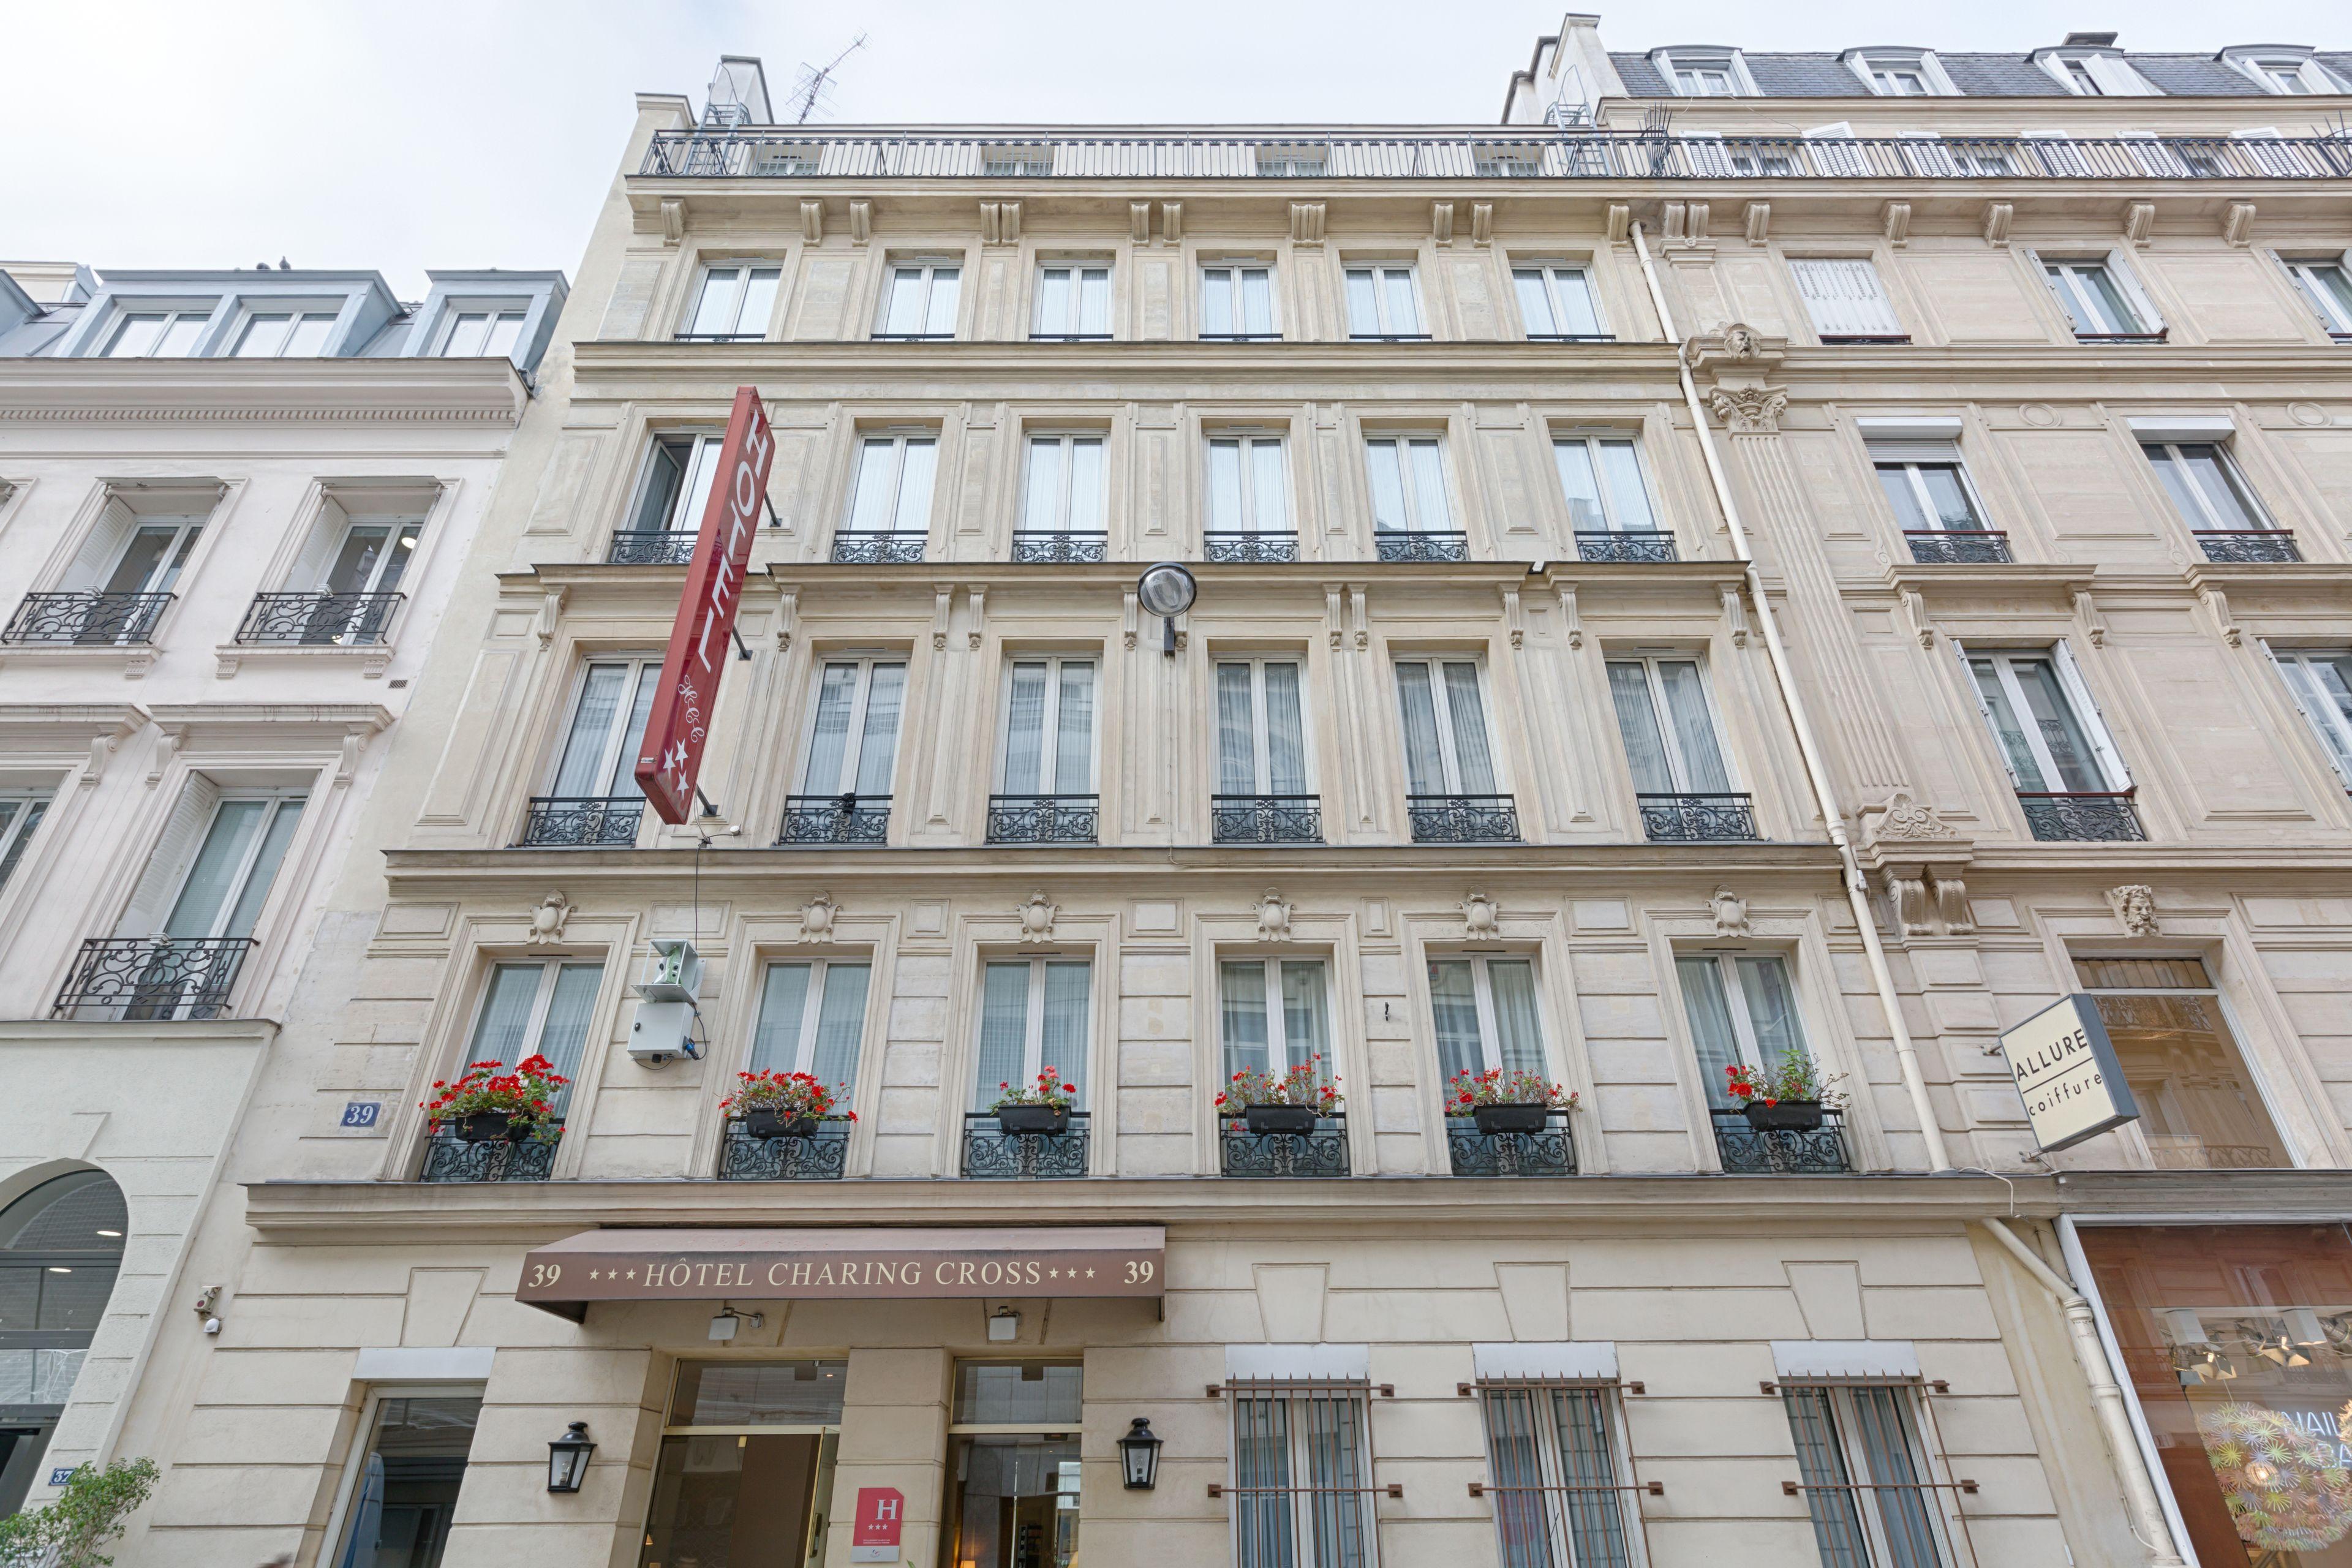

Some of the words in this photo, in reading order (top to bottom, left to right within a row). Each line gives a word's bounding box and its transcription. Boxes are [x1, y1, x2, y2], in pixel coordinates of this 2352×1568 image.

[698, 408, 769, 674] HOTEL
[2016, 1028, 2089, 1082] ALLURE
[2028, 1073, 2103, 1117] coiffure
[347, 1105, 374, 1124] 39
[527, 1264, 562, 1288] 39
[643, 1257, 754, 1287] HÔTEL
[767, 1262, 922, 1286] CHARING
[935, 1261, 1041, 1285] CROSS
[1123, 1260, 1155, 1284] 39
[53, 1470, 74, 1482] 37
[875, 1499, 900, 1520] H
